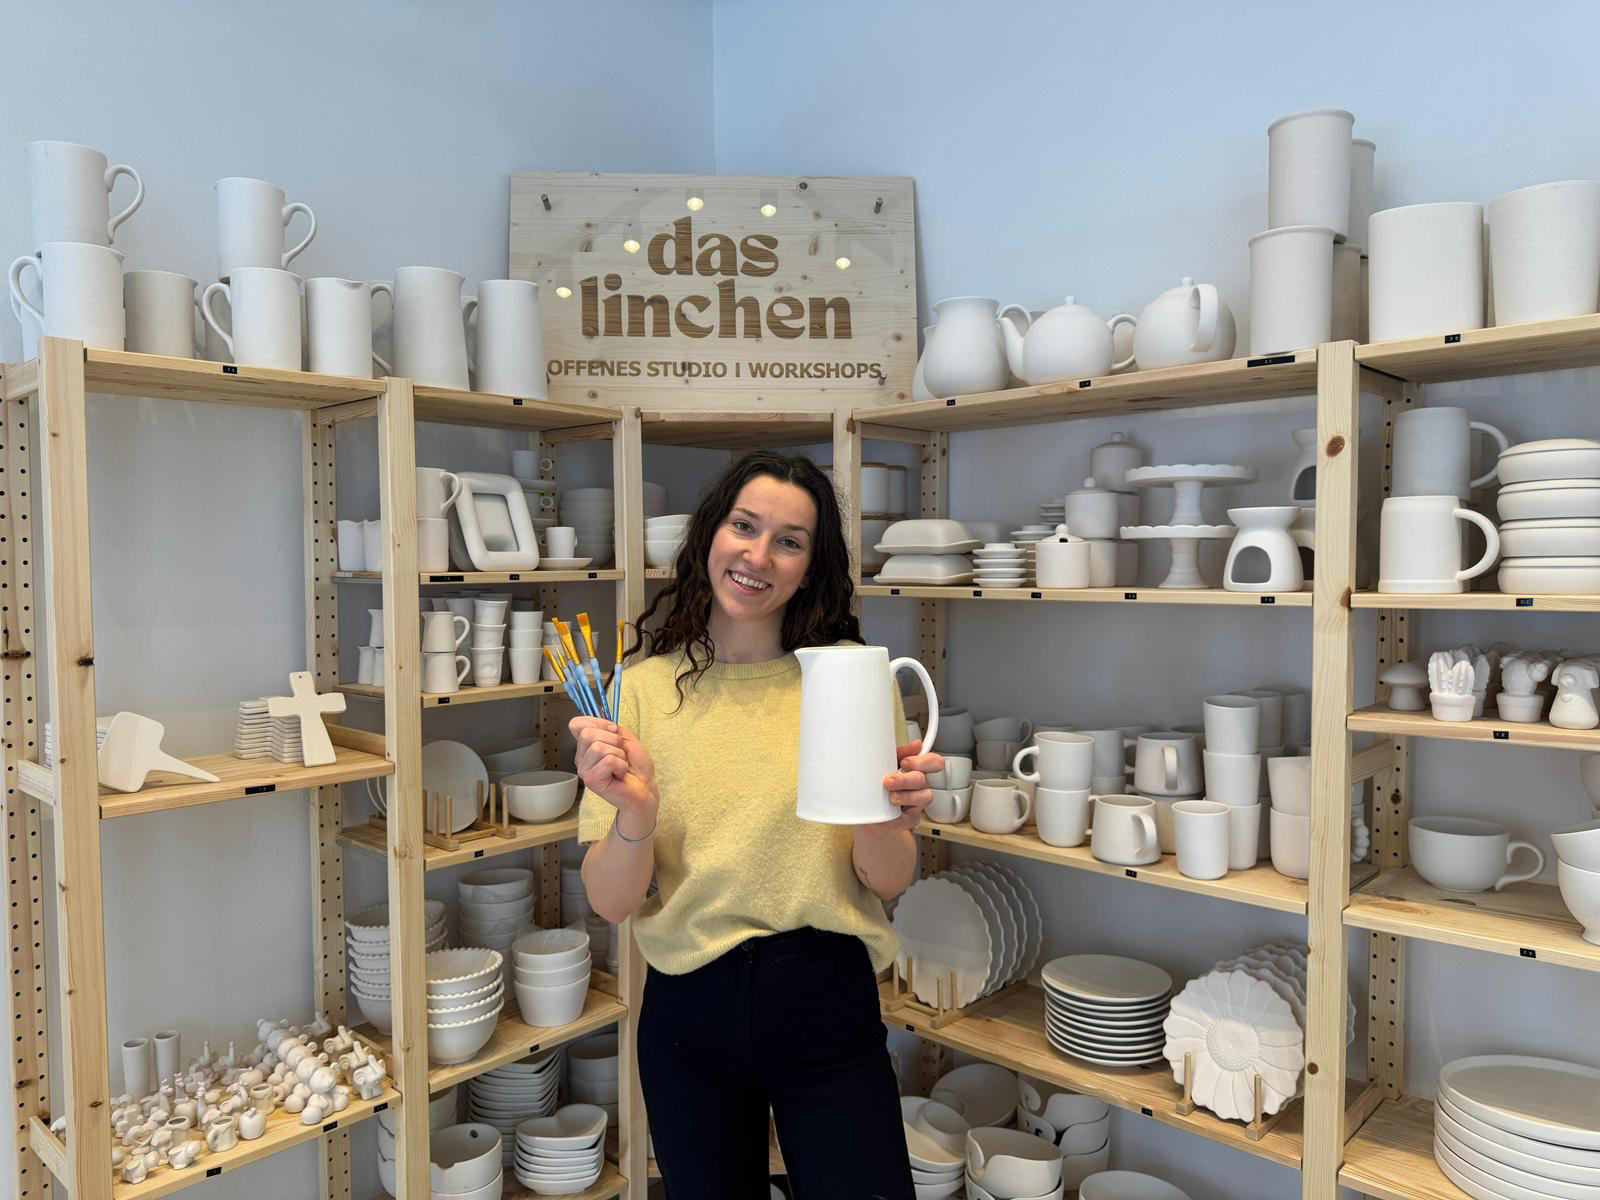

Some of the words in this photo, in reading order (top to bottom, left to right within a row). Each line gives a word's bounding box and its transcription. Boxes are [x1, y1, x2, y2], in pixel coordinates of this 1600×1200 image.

[648, 216, 779, 277] das
[579, 273, 853, 339] linchen
[547, 360, 641, 376] OFFENES
[647, 361, 727, 378] STUDIO
[748, 362, 882, 379] WORKSHOPS
